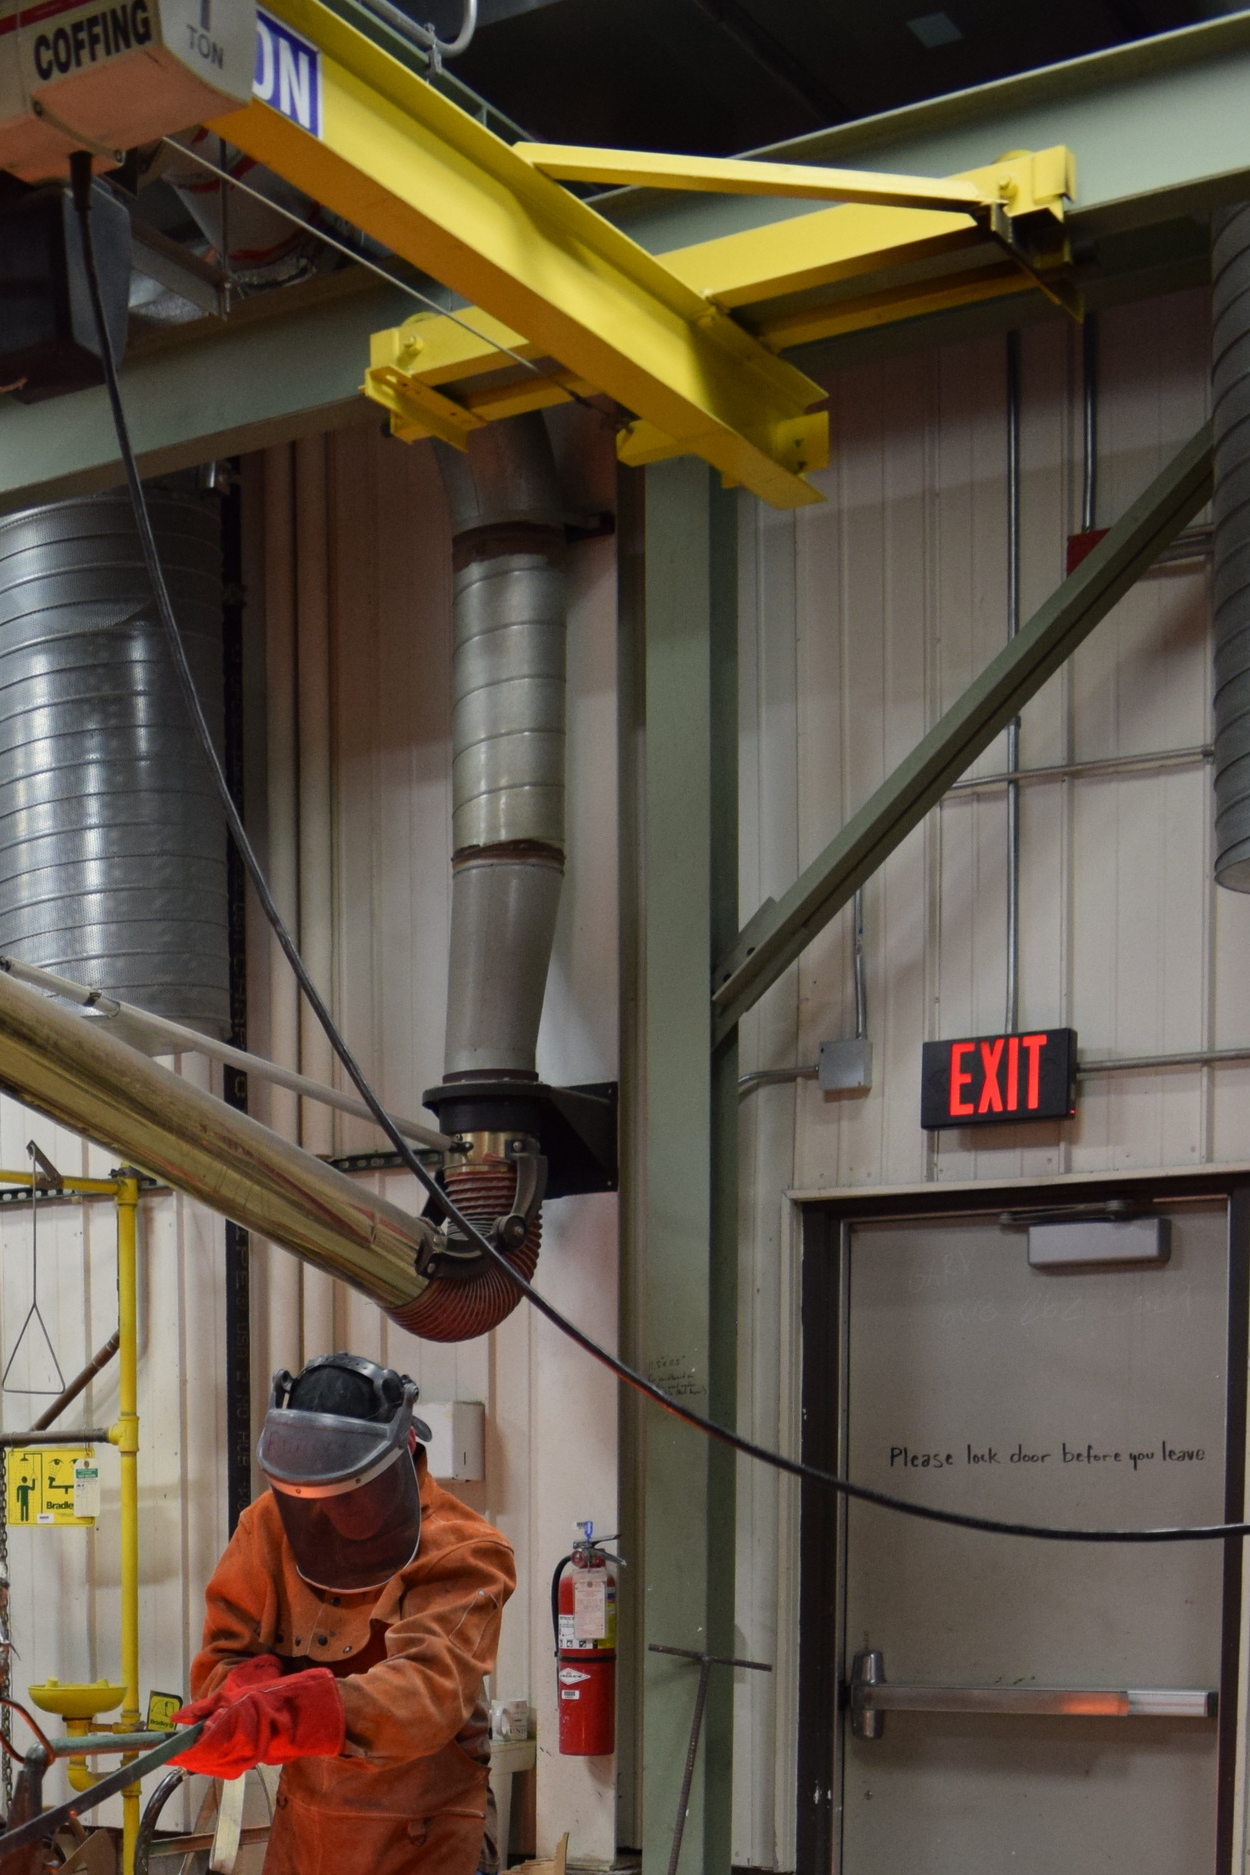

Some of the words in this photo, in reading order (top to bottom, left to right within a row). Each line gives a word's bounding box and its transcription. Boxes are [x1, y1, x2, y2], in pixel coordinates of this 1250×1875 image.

[33, 0, 150, 80] COFFING
[187, 24, 224, 69] TON
[252, 17, 310, 129] ON
[949, 1034, 1047, 1116] EXIT
[890, 1446, 953, 1468] Please
[967, 1444, 1000, 1464] lock
[1010, 1443, 1051, 1463] door
[1062, 1442, 1122, 1464] before
[1129, 1451, 1154, 1471] you
[1162, 1440, 1206, 1461] leave
[46, 1501, 74, 1510] Bradle
